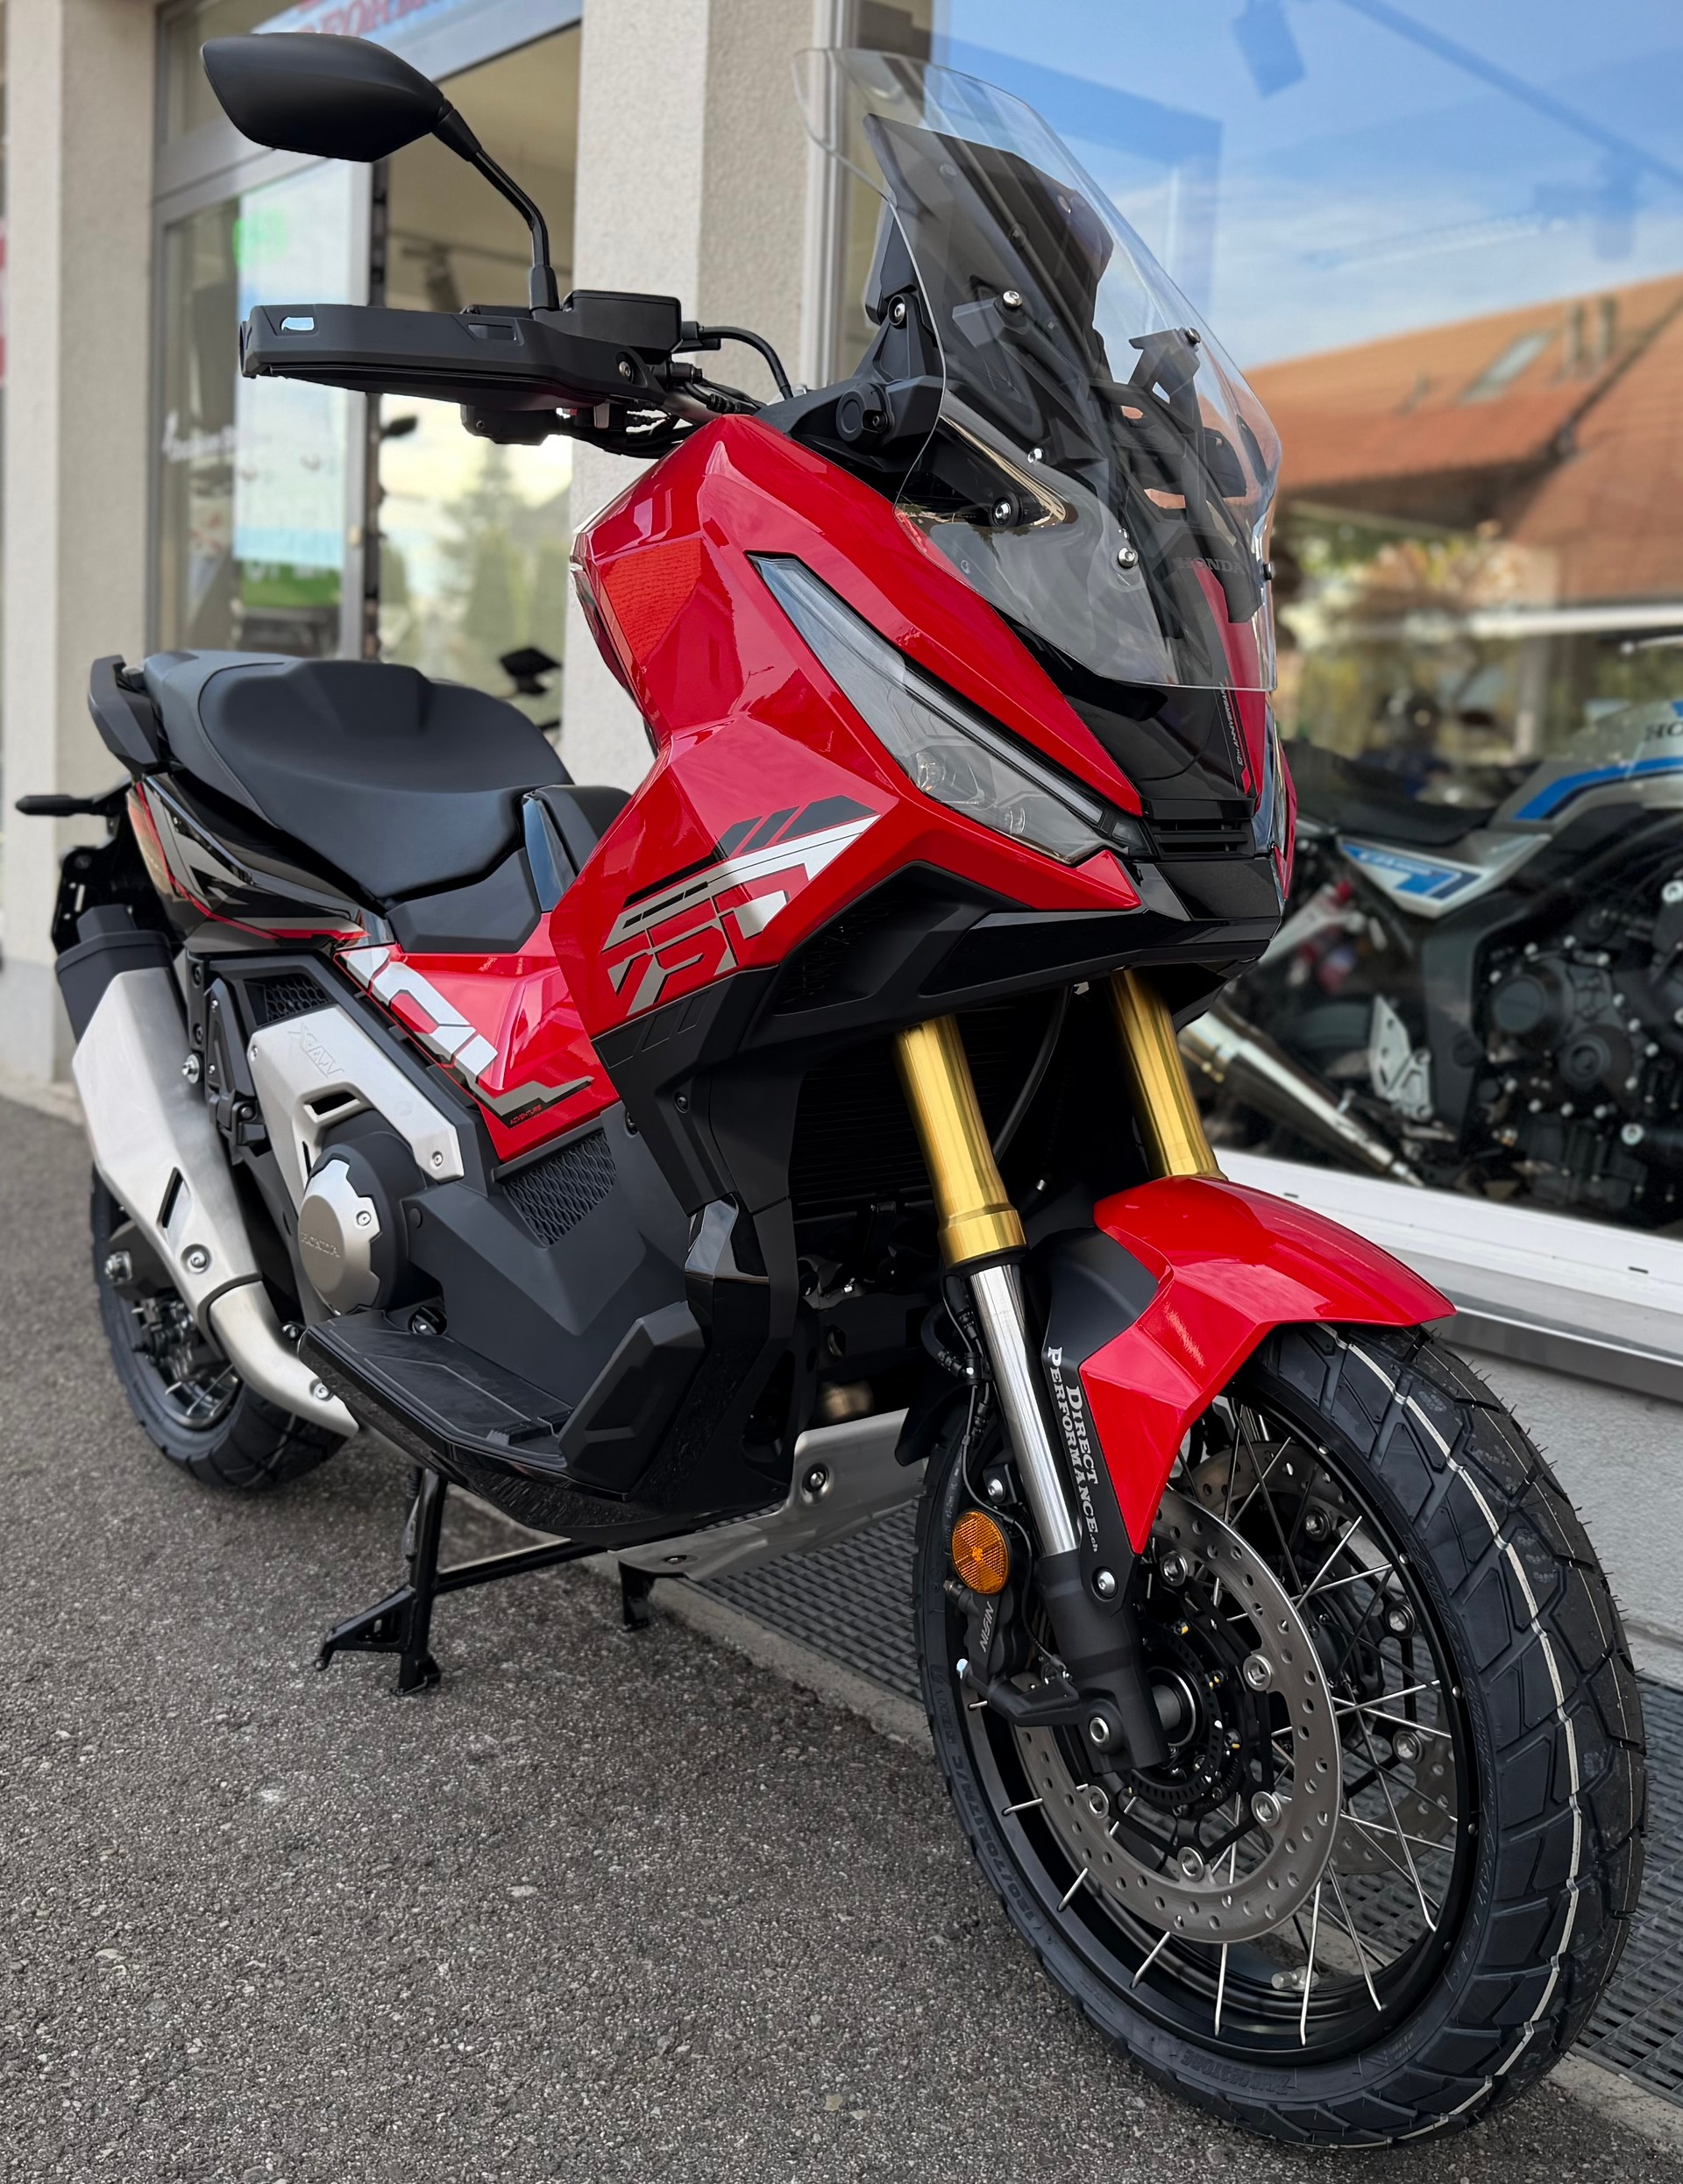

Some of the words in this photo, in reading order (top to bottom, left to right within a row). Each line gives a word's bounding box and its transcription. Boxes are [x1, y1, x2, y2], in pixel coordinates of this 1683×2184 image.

[1176, 557, 1246, 574] HONDA
[301, 1231, 341, 1258] HONDA
[1066, 1385, 1099, 1485] DIRECT
